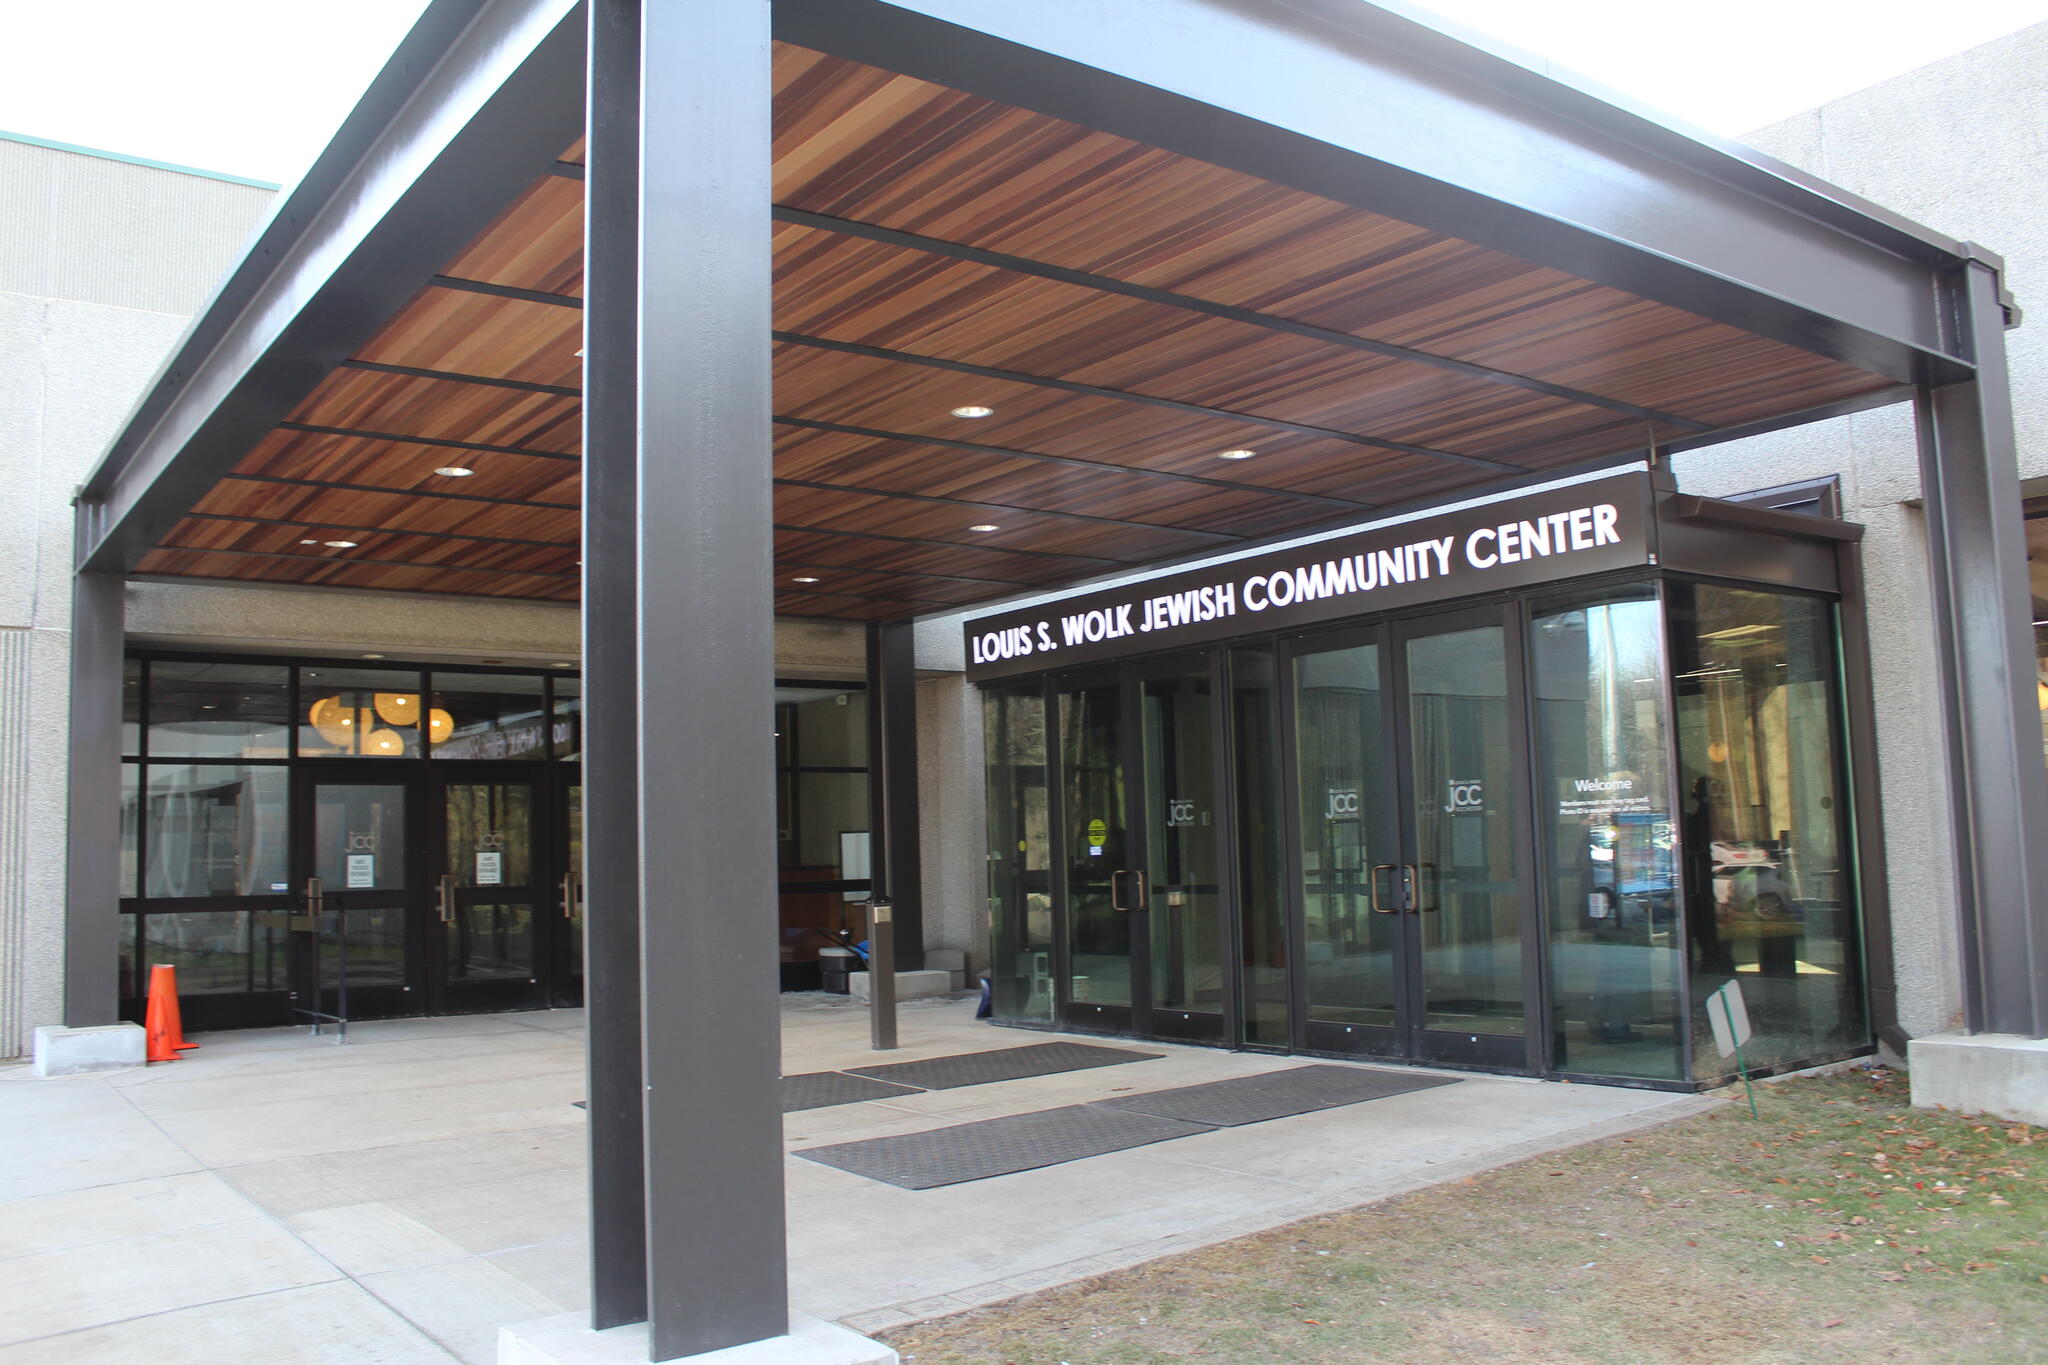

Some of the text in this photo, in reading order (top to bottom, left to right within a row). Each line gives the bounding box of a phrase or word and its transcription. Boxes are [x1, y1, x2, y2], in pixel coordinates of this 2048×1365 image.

[973, 504, 1620, 663] LOUIS S. WOLK JEWISH COMMUNITY CENTER
[1575, 778, 1633, 792] Welcome
